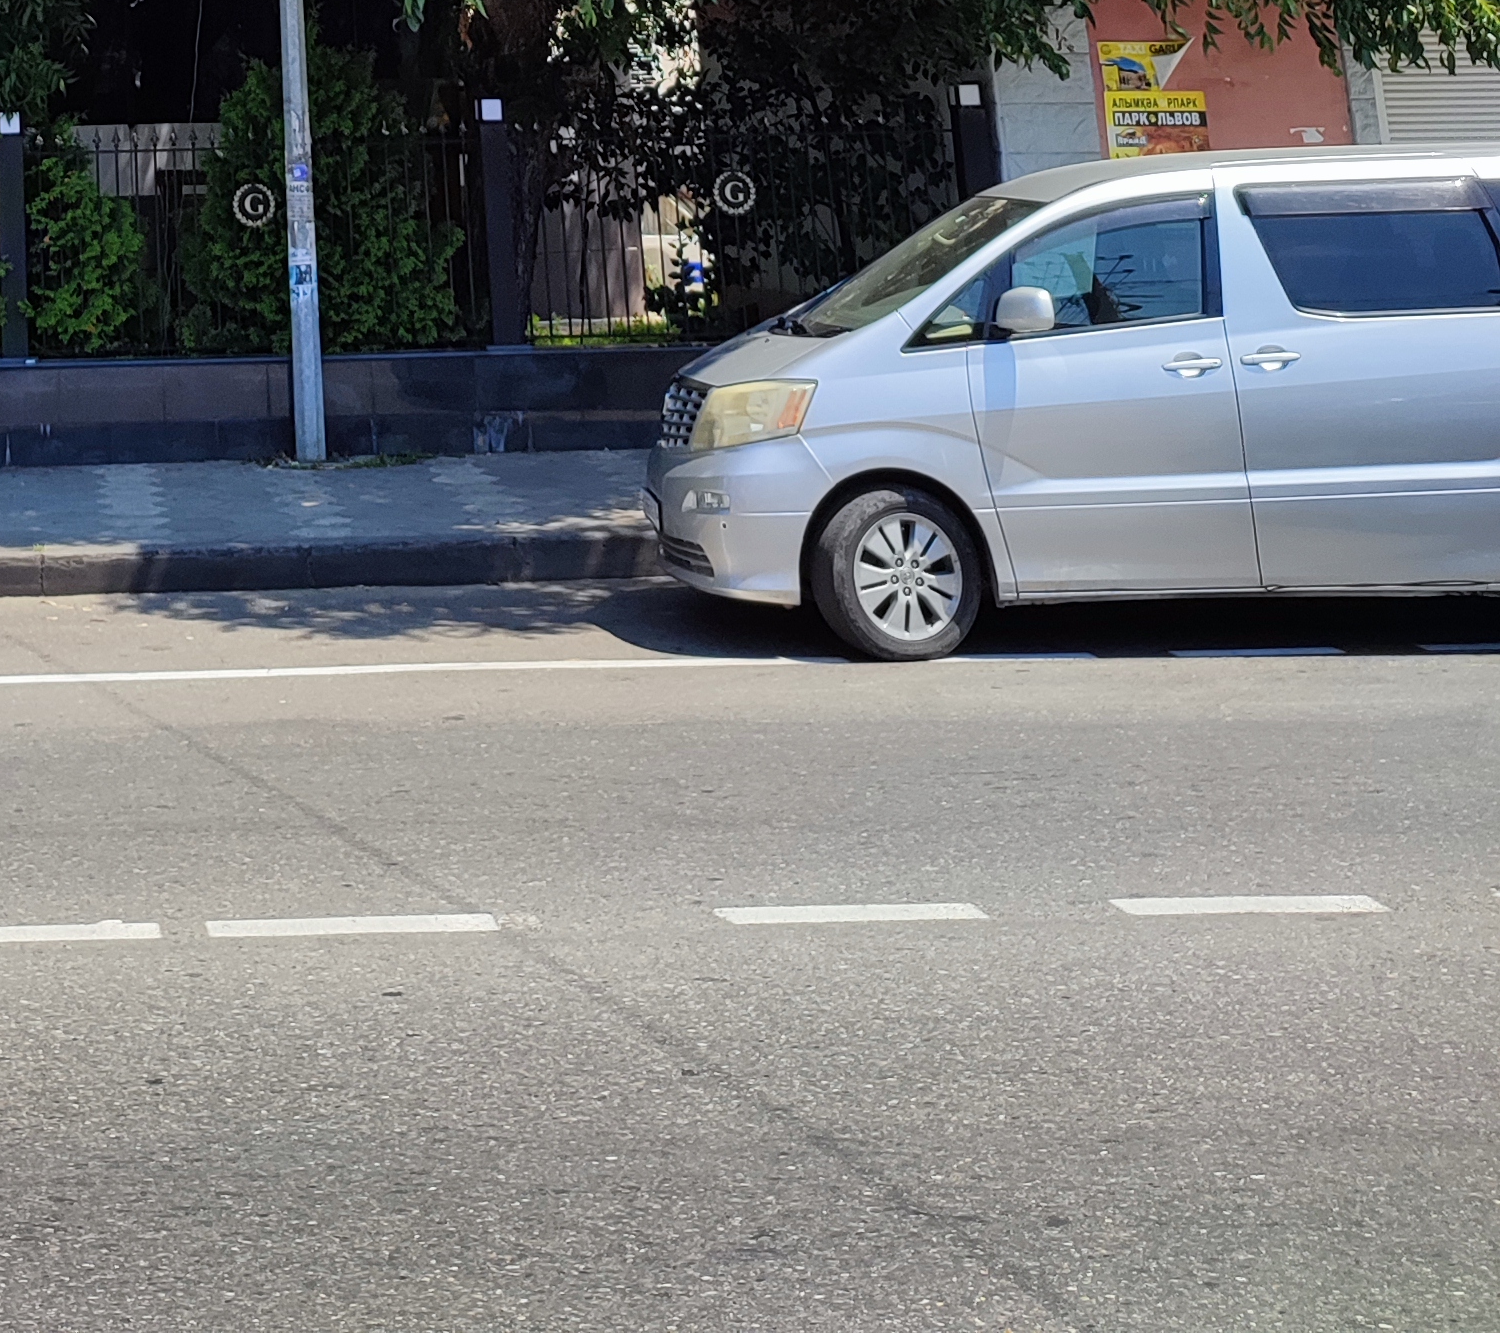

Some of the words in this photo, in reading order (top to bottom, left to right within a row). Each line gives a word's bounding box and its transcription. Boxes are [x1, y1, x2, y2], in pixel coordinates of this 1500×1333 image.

[1167, 97, 1198, 108] РПАРК
[1114, 112, 1149, 125] ПАРК
[1157, 112, 1200, 126] ЛЬВОВ
[724, 181, 744, 203] G
[244, 193, 264, 215] G
